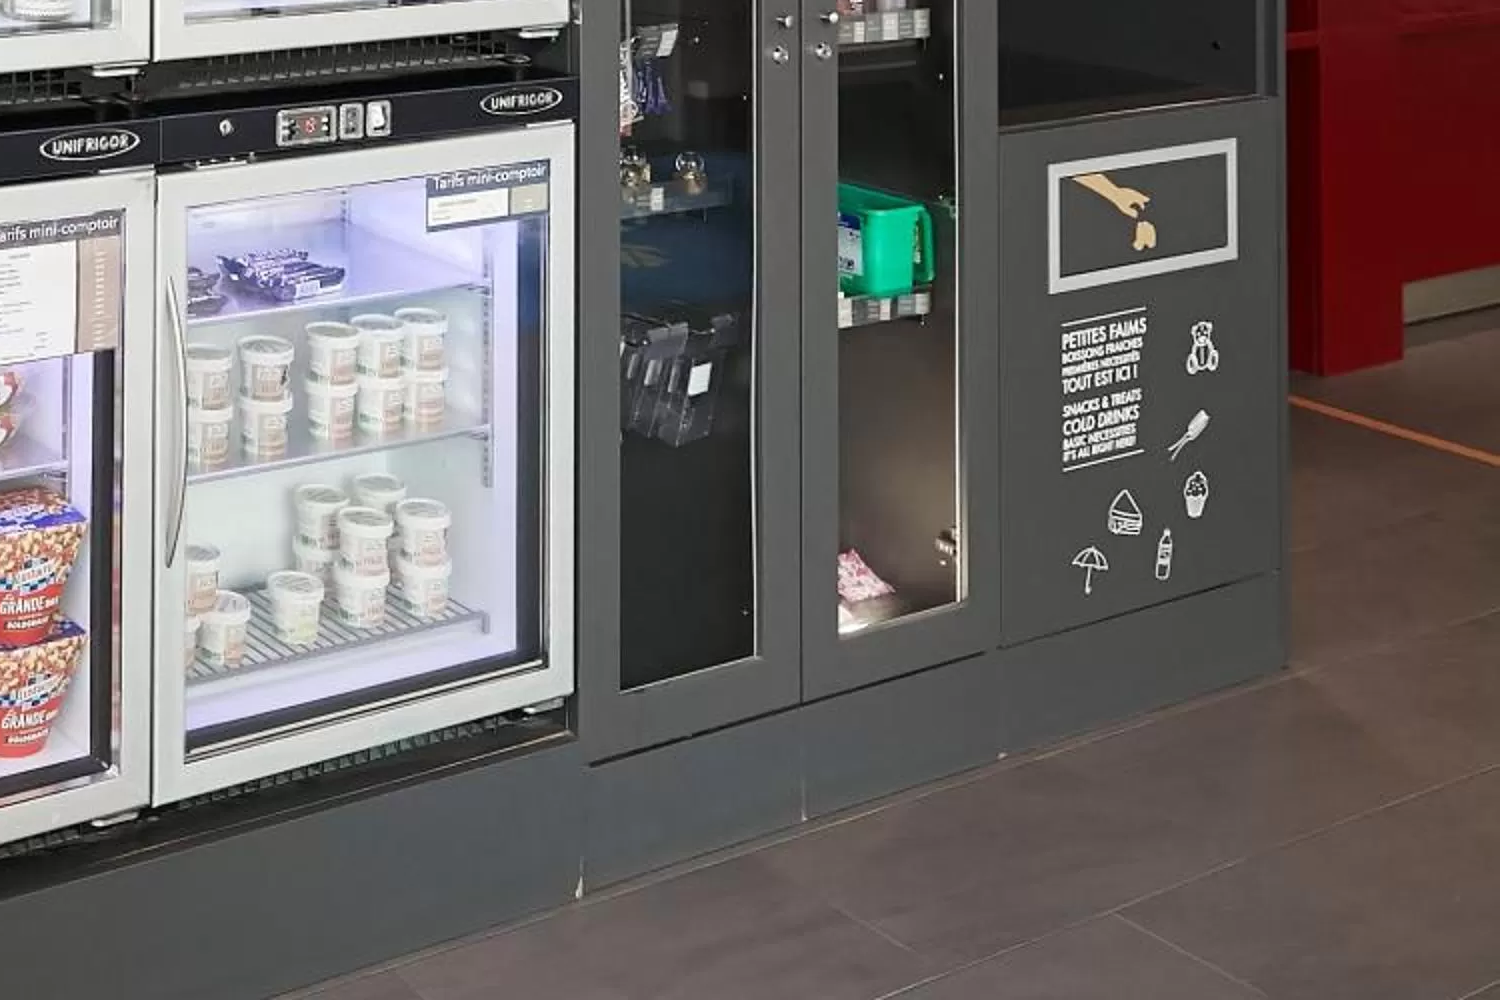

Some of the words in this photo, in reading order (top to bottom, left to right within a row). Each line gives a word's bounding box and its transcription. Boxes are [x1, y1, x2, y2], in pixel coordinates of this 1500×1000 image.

[489, 90, 553, 111] UNIFRIGOR
[51, 132, 130, 156] UNIFRIGOR
[434, 171, 465, 191] Tarifs
[29, 215, 120, 239] mini-comptoir
[1061, 325, 1107, 350] PETITES
[1109, 317, 1147, 340] FAIMS
[1061, 373, 1093, 395] TOUT
[1094, 368, 1115, 387] EST
[1115, 365, 1132, 382] ICI
[1061, 397, 1101, 417] SNACKS
[1111, 388, 1142, 407] TREATS
[1063, 414, 1096, 435] COLD
[1097, 404, 1141, 428] DRINKS
[0, 596, 45, 616] GRANDE
[1, 711, 46, 730] GRANDE
